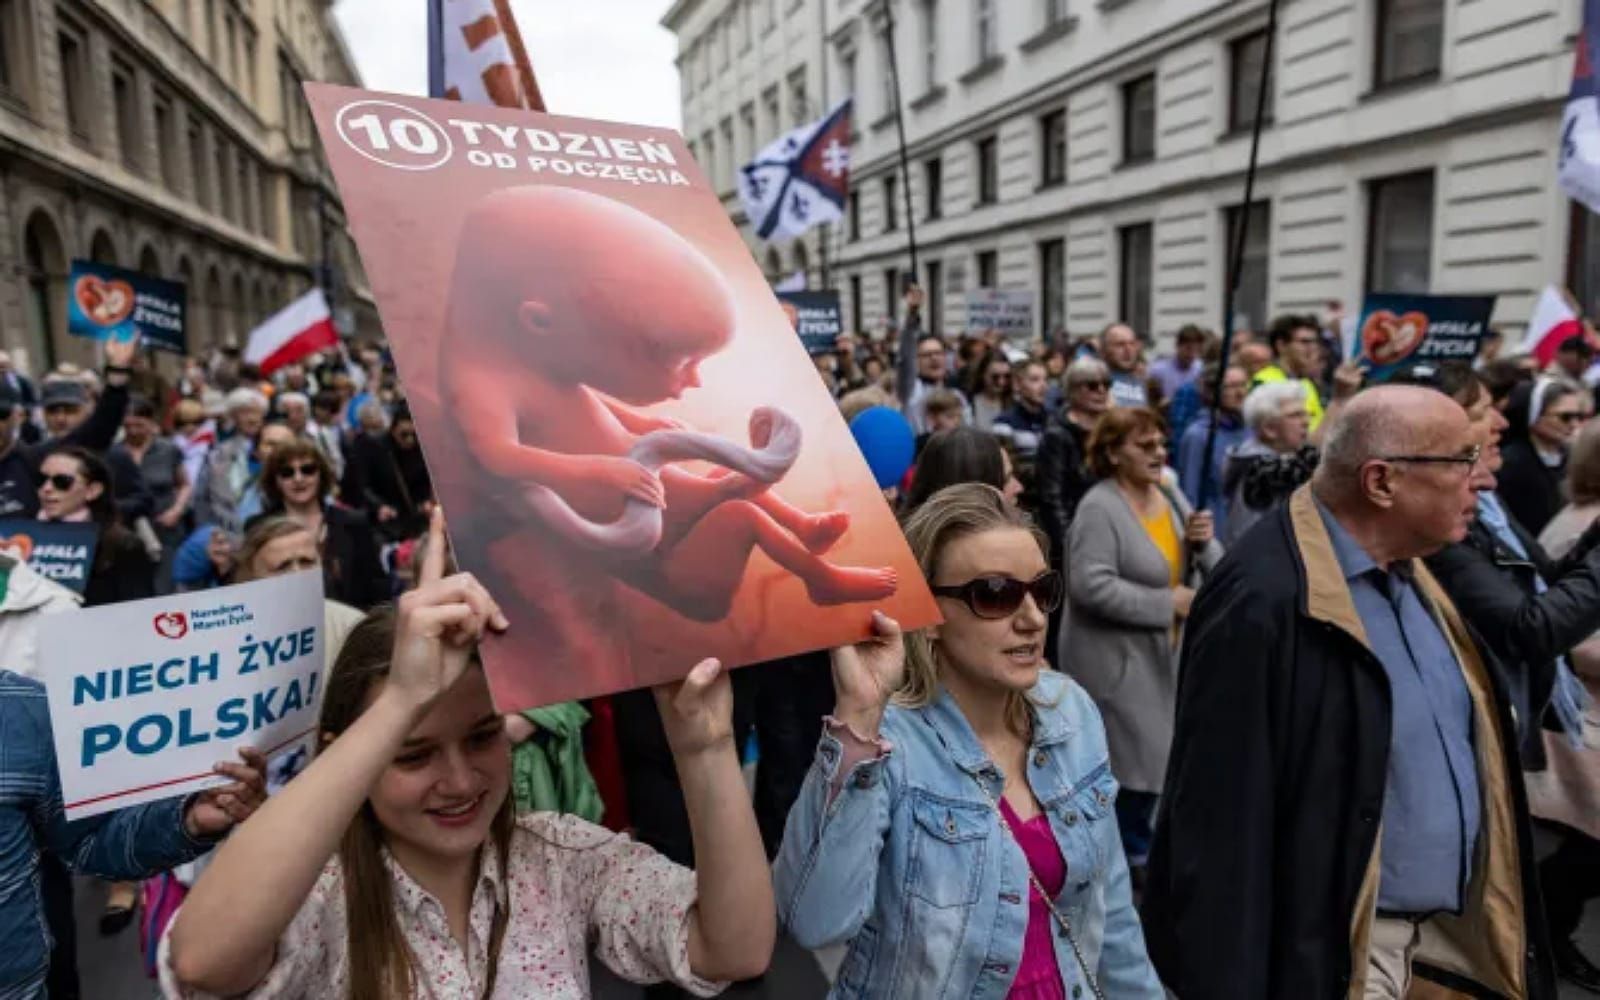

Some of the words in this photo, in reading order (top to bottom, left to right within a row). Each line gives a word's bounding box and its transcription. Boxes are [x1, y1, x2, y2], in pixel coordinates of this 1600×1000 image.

[348, 113, 439, 155] 10
[448, 118, 678, 167] TYDZIEŃ
[467, 151, 518, 170] OD
[527, 155, 691, 187] POCZĘCIA
[73, 652, 219, 706] NIECH
[237, 632, 316, 675] ŻYJE
[81, 672, 317, 768] POLSKA!
